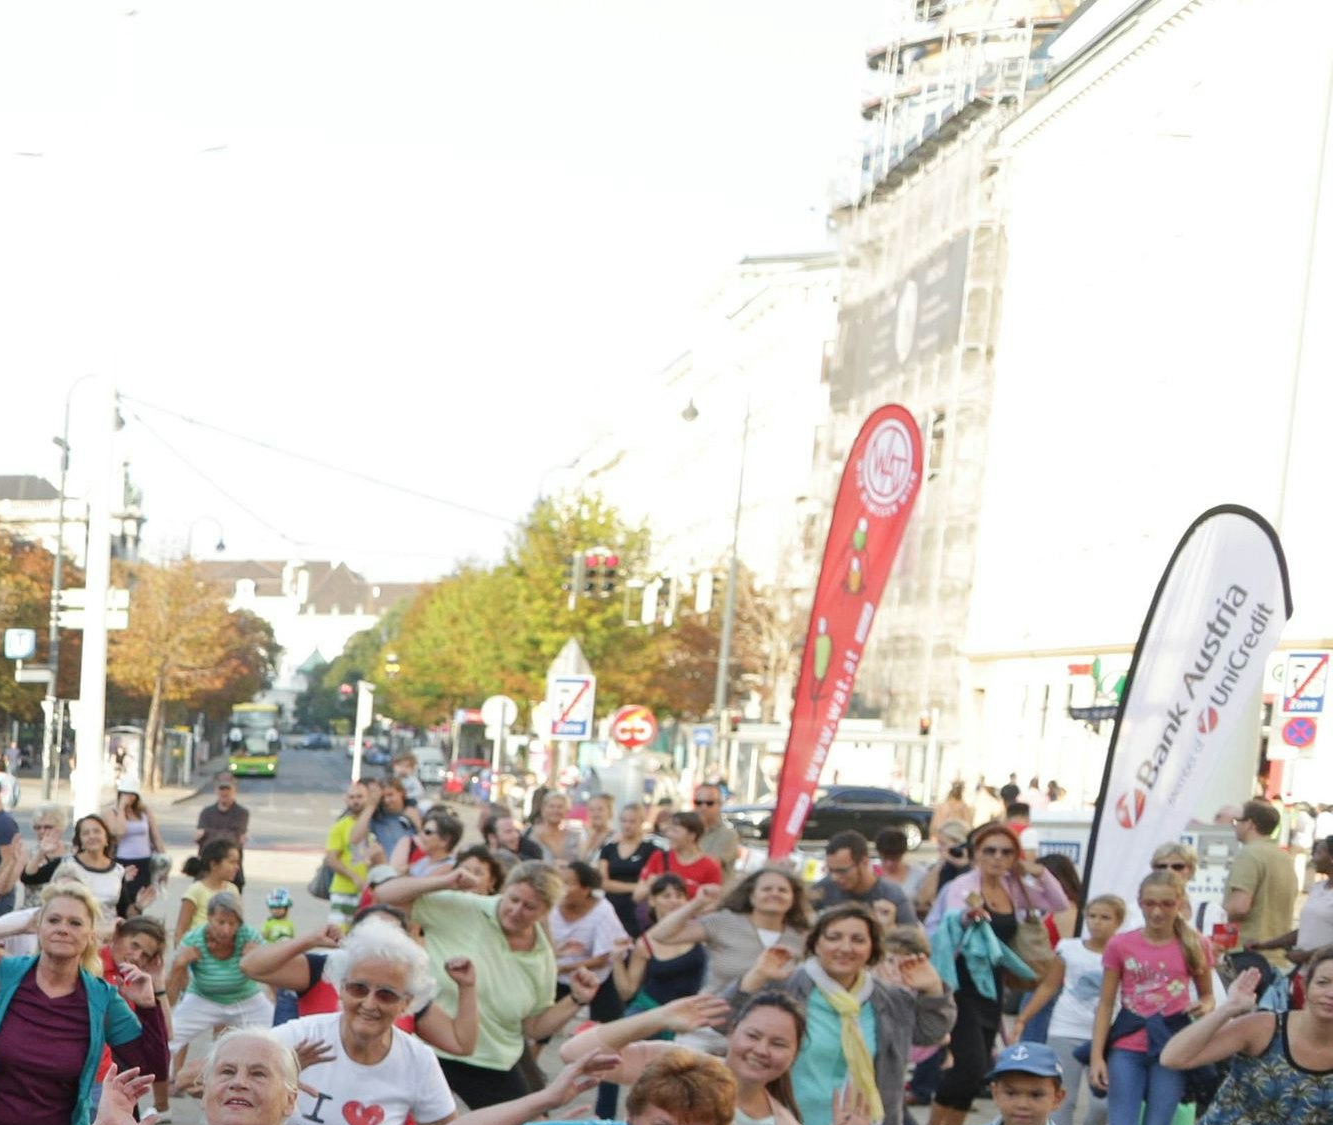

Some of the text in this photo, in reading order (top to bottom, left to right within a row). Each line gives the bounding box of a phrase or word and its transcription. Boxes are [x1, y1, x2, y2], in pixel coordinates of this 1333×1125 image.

[1136, 584, 1248, 790] Bank Austria
[1210, 602, 1274, 707] UniCredit
[805, 650, 859, 783] www.wat.at
[301, 1092, 333, 1124] I
